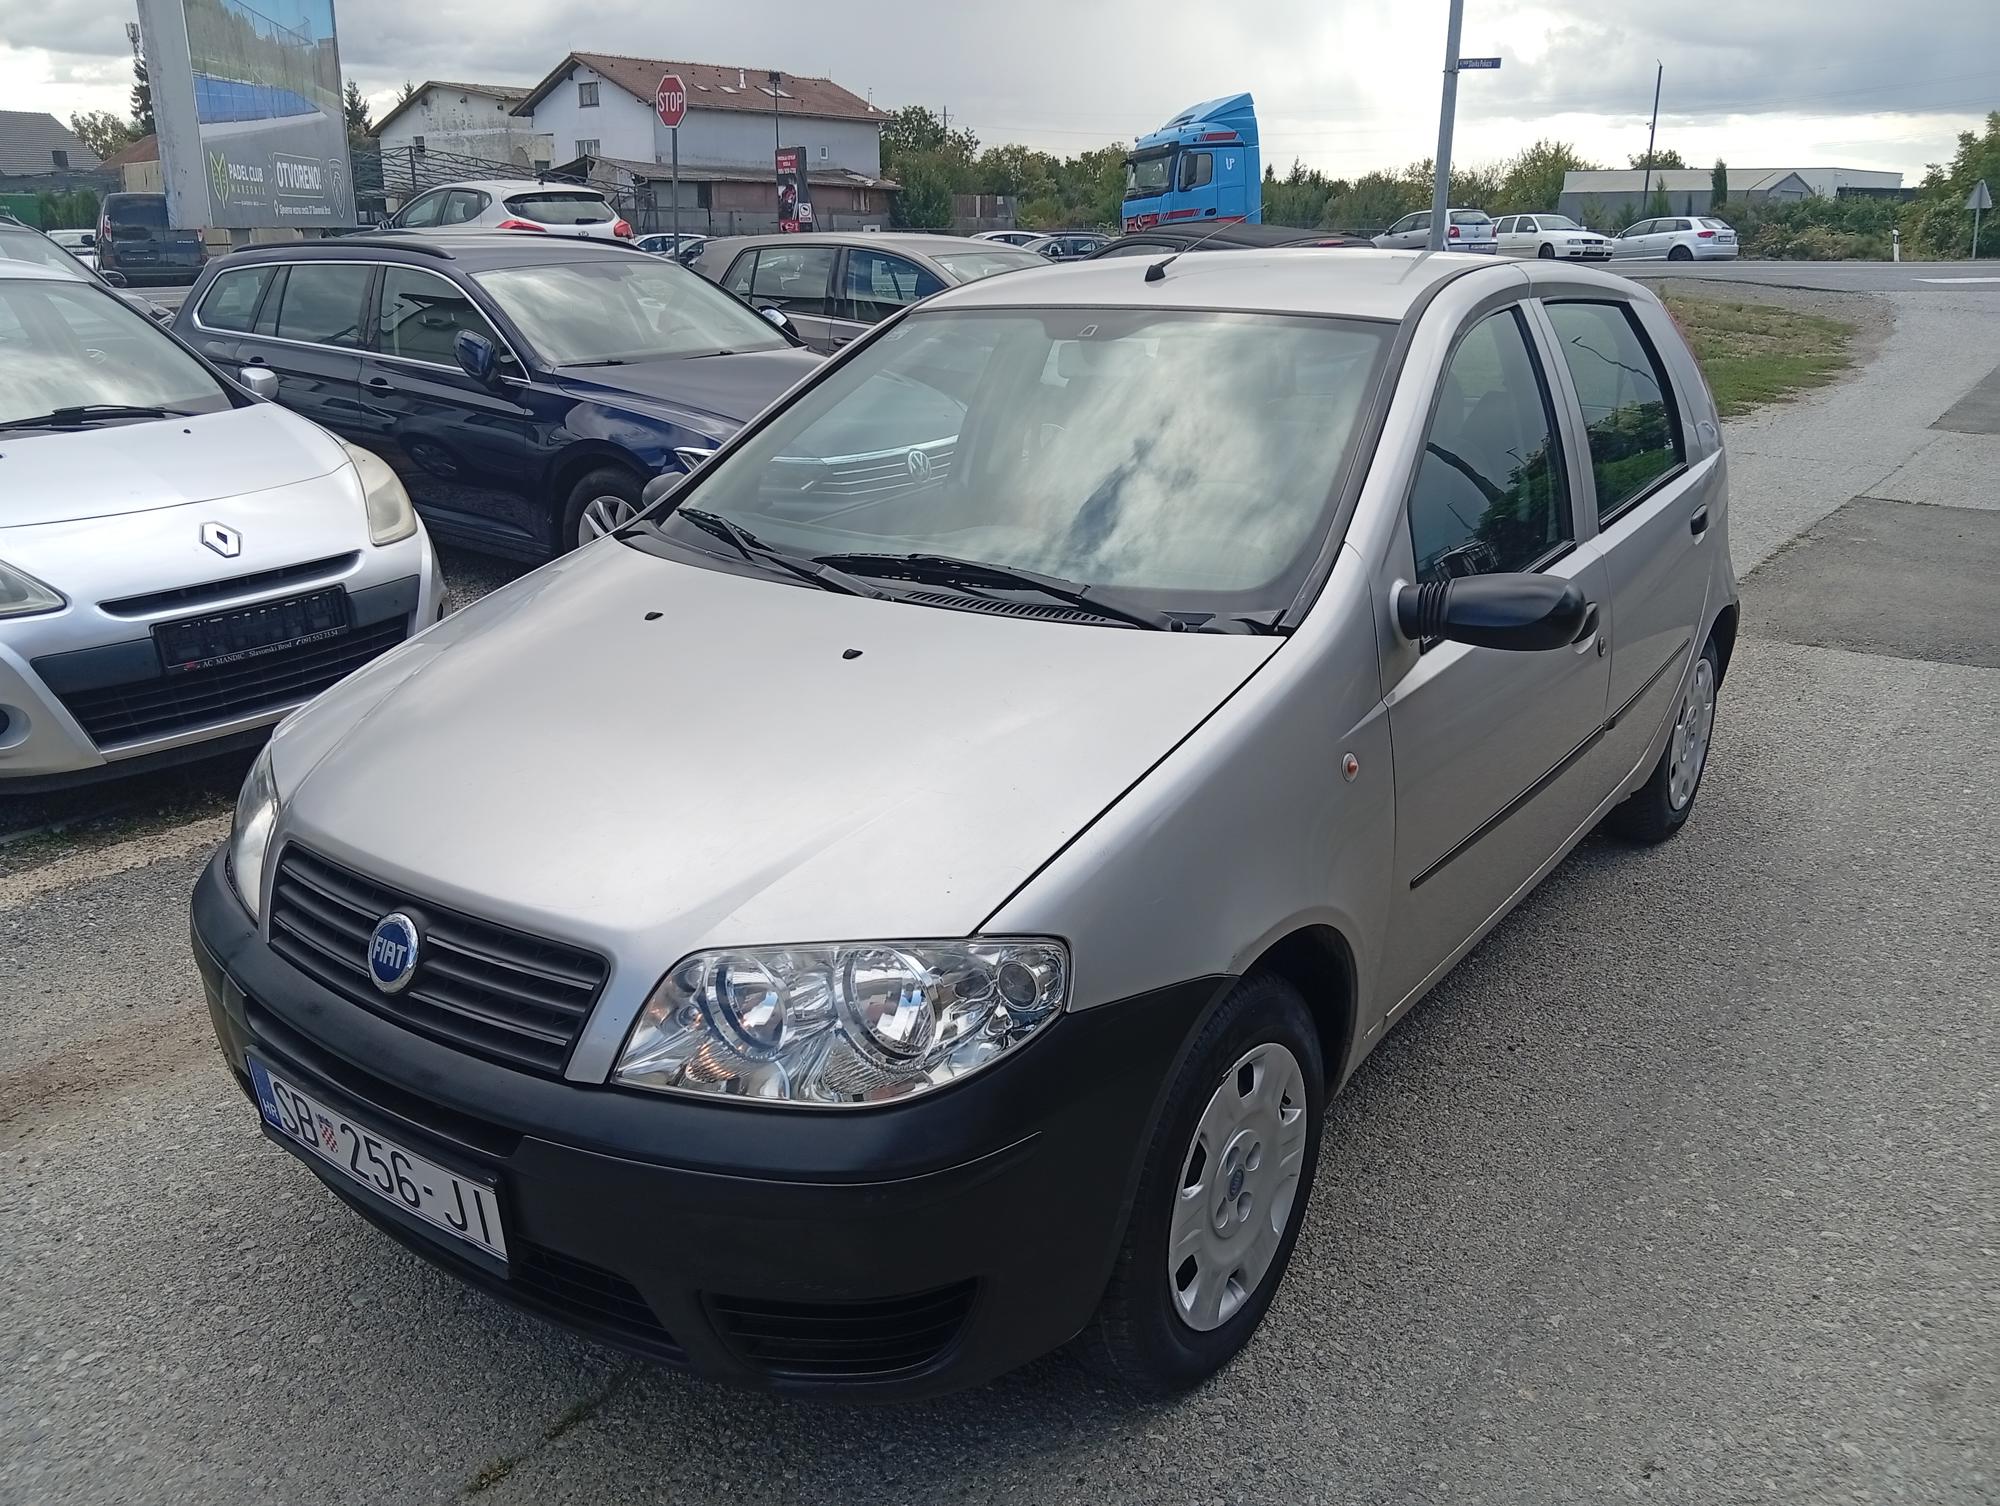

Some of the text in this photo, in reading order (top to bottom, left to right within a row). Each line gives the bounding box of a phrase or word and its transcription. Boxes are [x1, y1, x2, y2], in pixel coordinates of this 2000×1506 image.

[658, 91, 683, 113] STOP
[228, 163, 264, 183] PADEL CLUB
[276, 161, 322, 190] OTVORENO!
[202, 660, 214, 668] AC
[249, 645, 278, 658] Slavonski
[278, 641, 292, 651] Brod
[373, 935, 407, 970] FIAT
[263, 1099, 280, 1121] HR
[273, 1081, 492, 1245] SB 256-JI
